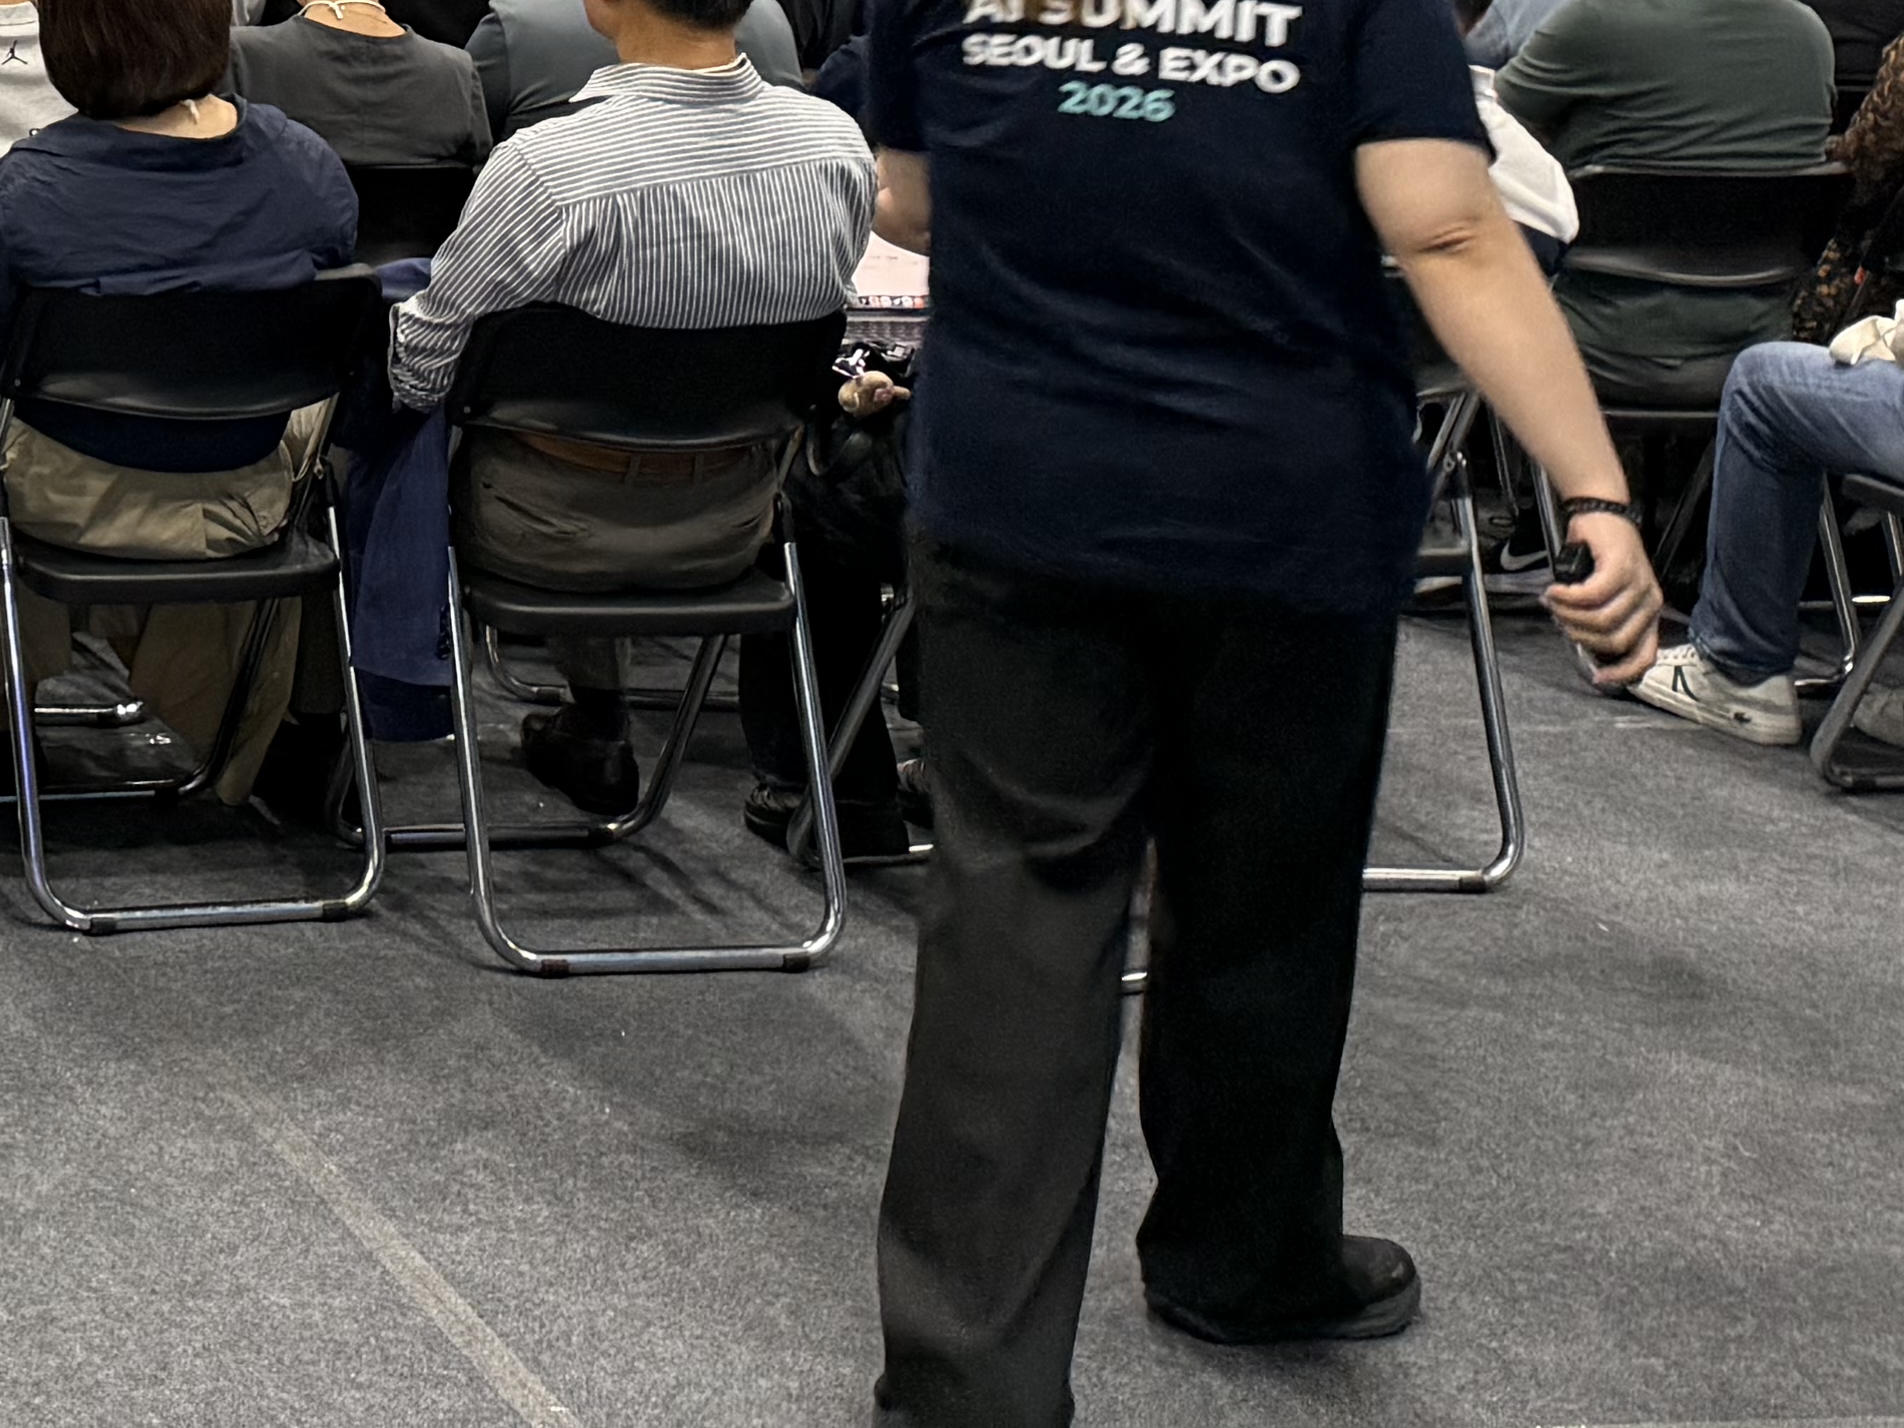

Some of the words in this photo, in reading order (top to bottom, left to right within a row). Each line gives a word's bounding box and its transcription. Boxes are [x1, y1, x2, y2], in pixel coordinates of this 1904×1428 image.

[962, 32, 1107, 74] SEOUL
[1112, 42, 1151, 76] &
[1158, 46, 1301, 95] EXPO
[1057, 79, 1176, 123] 2026
